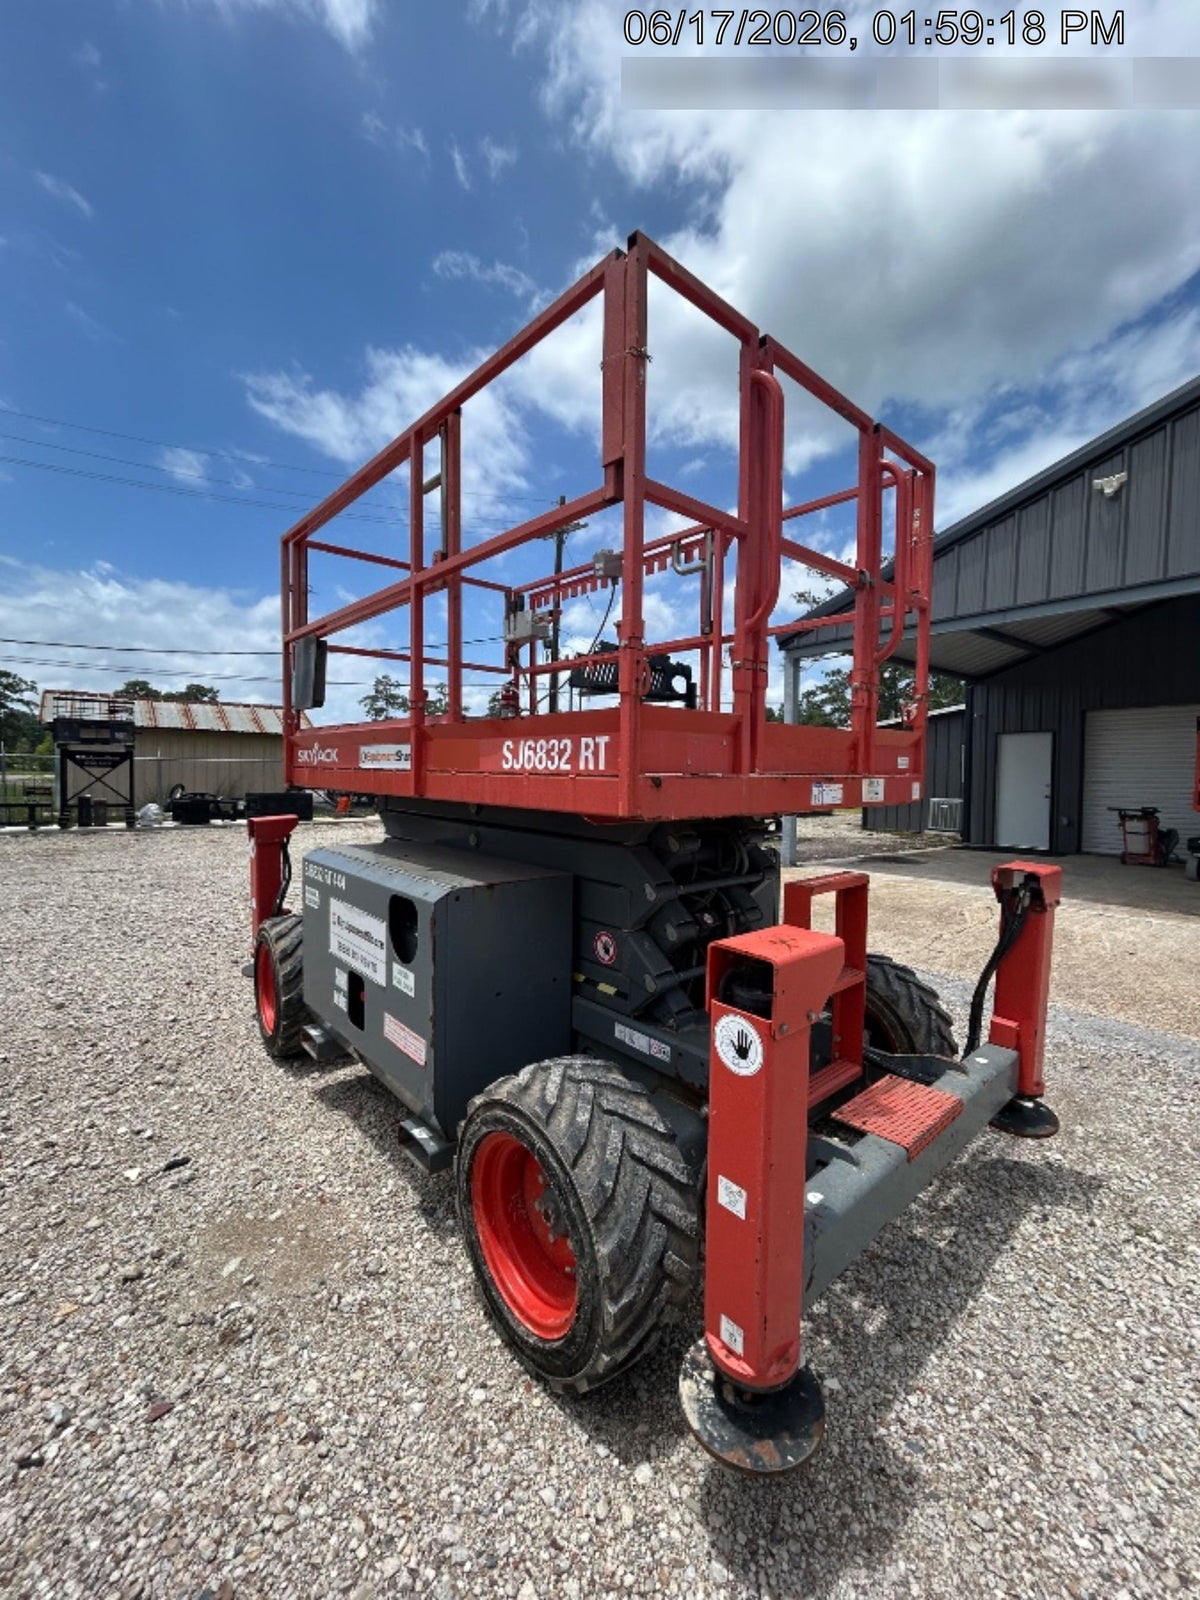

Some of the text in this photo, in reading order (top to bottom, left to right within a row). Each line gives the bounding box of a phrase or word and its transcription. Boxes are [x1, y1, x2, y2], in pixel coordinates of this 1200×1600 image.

[297, 742, 338, 765] SKYJACK
[502, 735, 611, 771] SJ6832 RT
